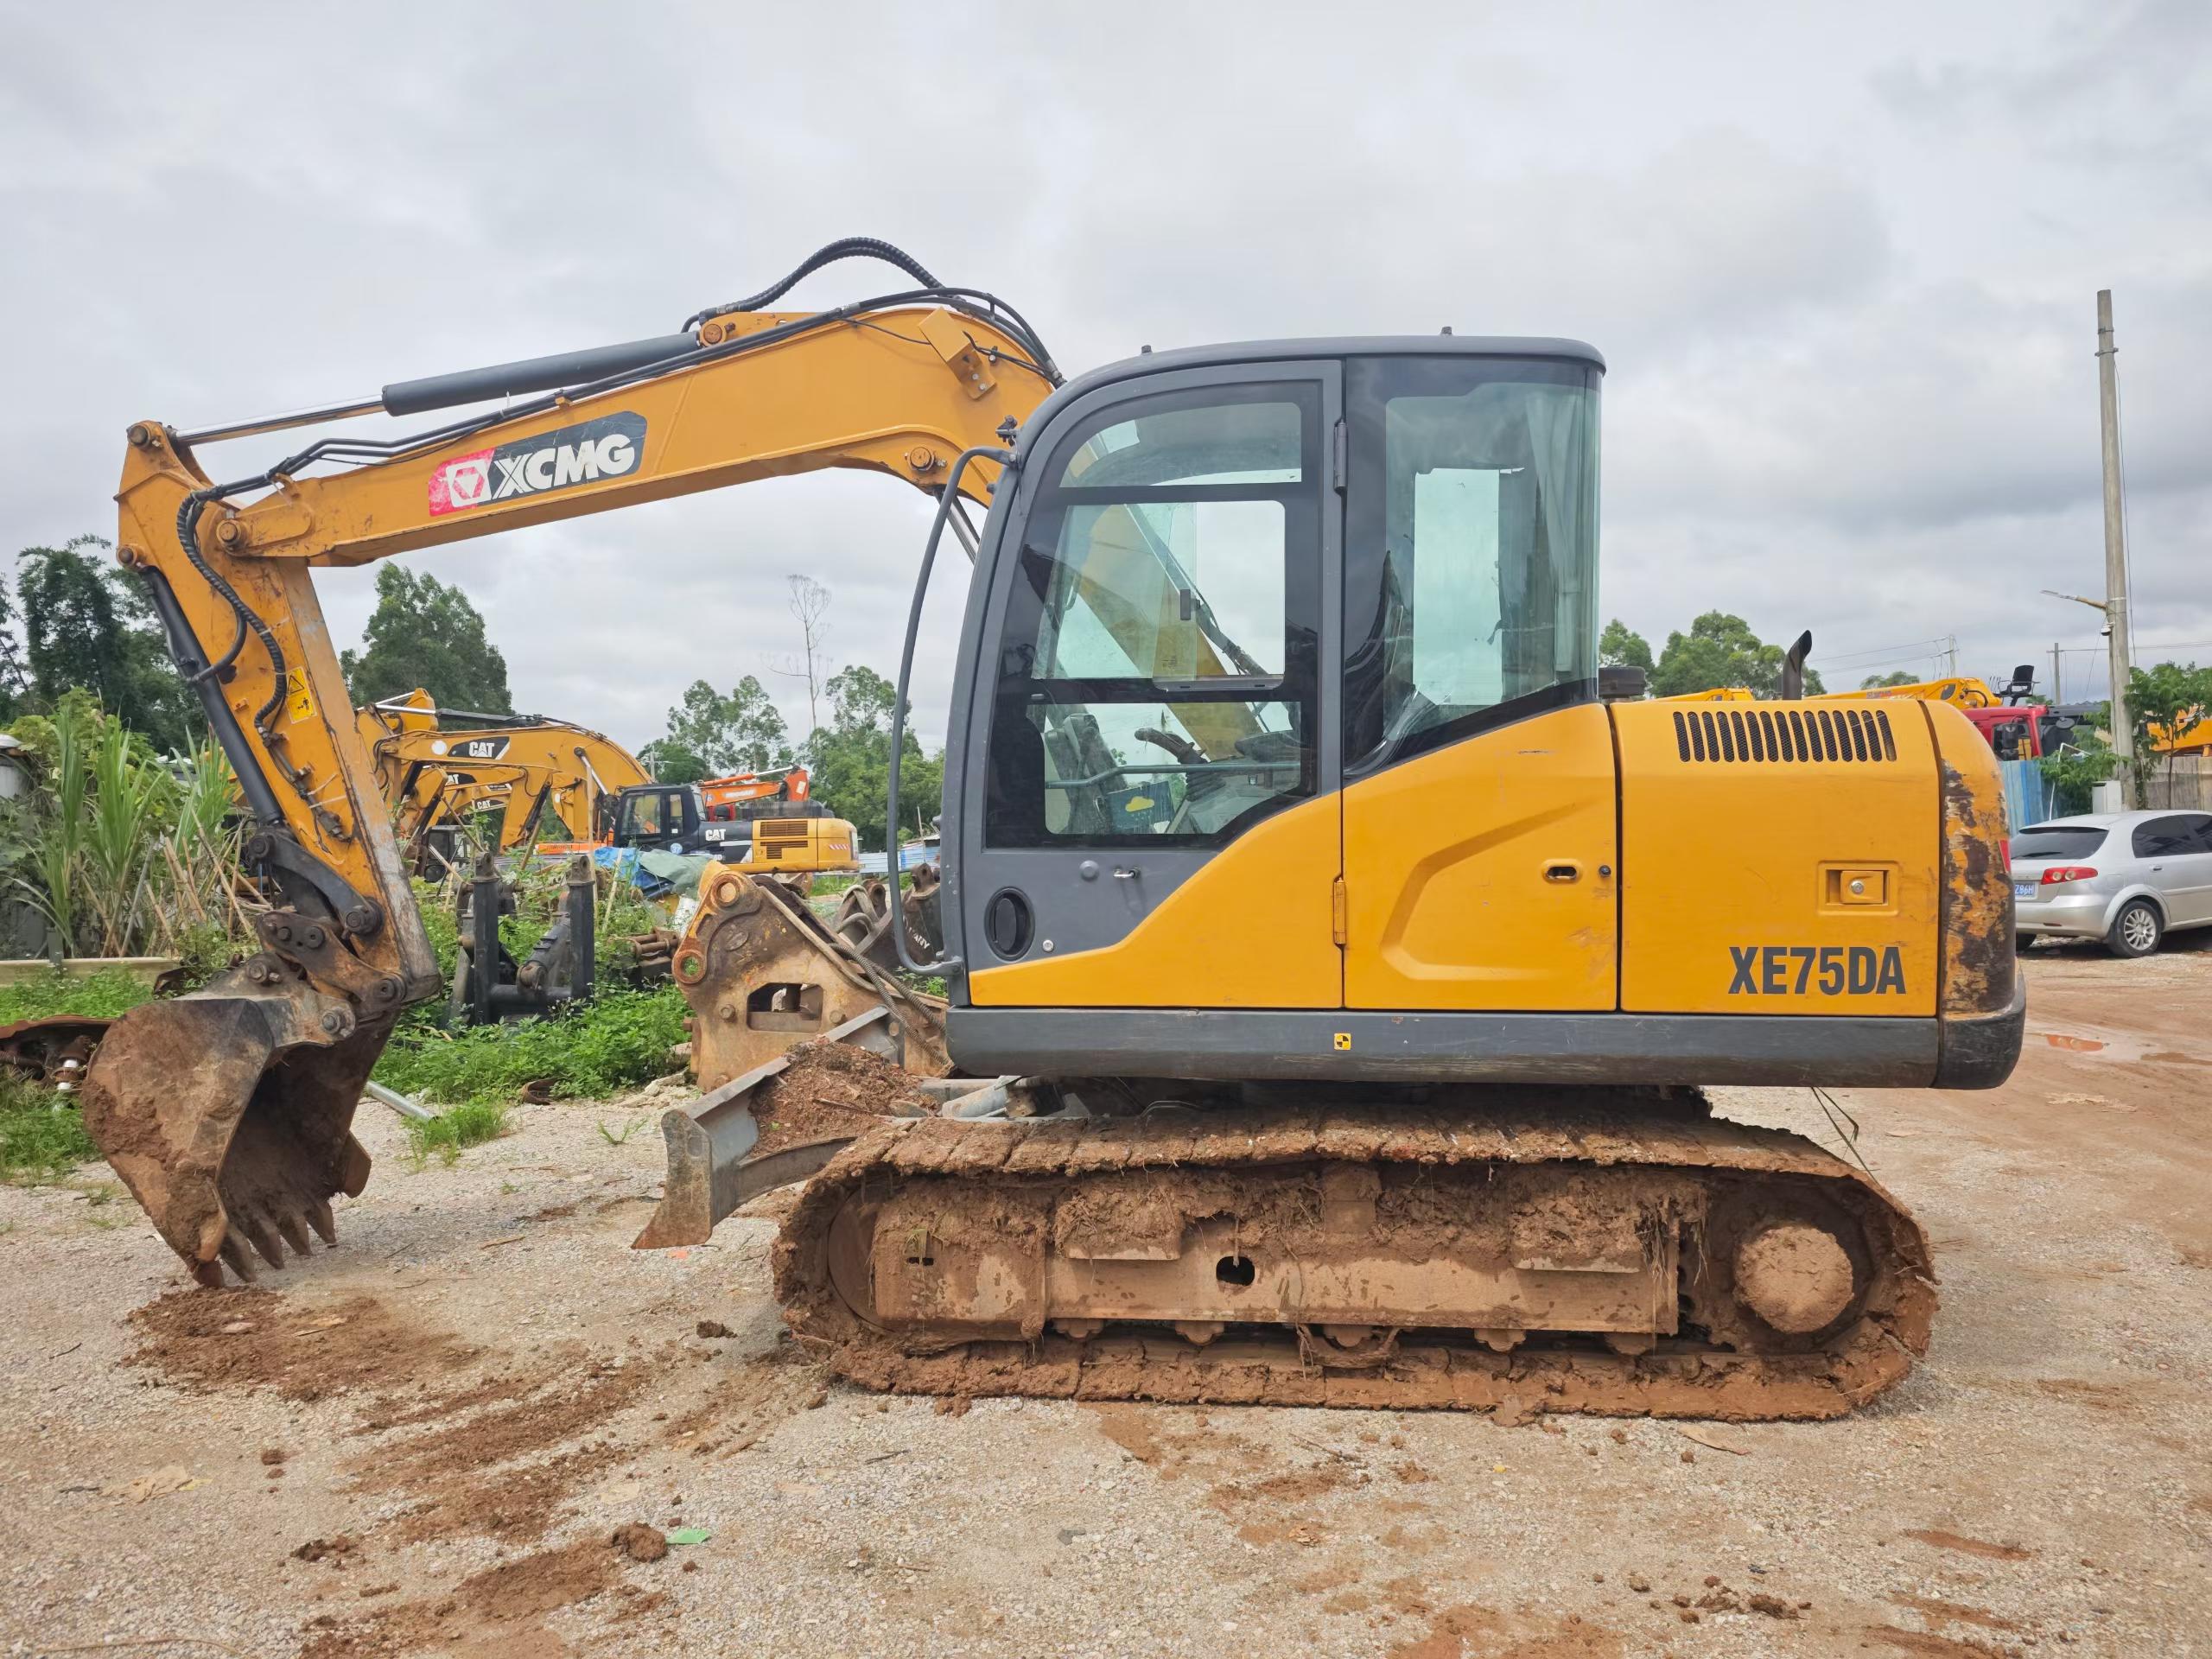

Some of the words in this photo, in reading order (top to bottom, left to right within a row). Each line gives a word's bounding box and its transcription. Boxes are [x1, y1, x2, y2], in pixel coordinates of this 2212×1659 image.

[492, 434, 635, 499] XCMG
[468, 741, 495, 758] CAT
[444, 774, 459, 785] AT
[476, 800, 491, 810] CAT
[705, 829, 727, 842] CAT
[1728, 946, 1906, 995] XE75DA
